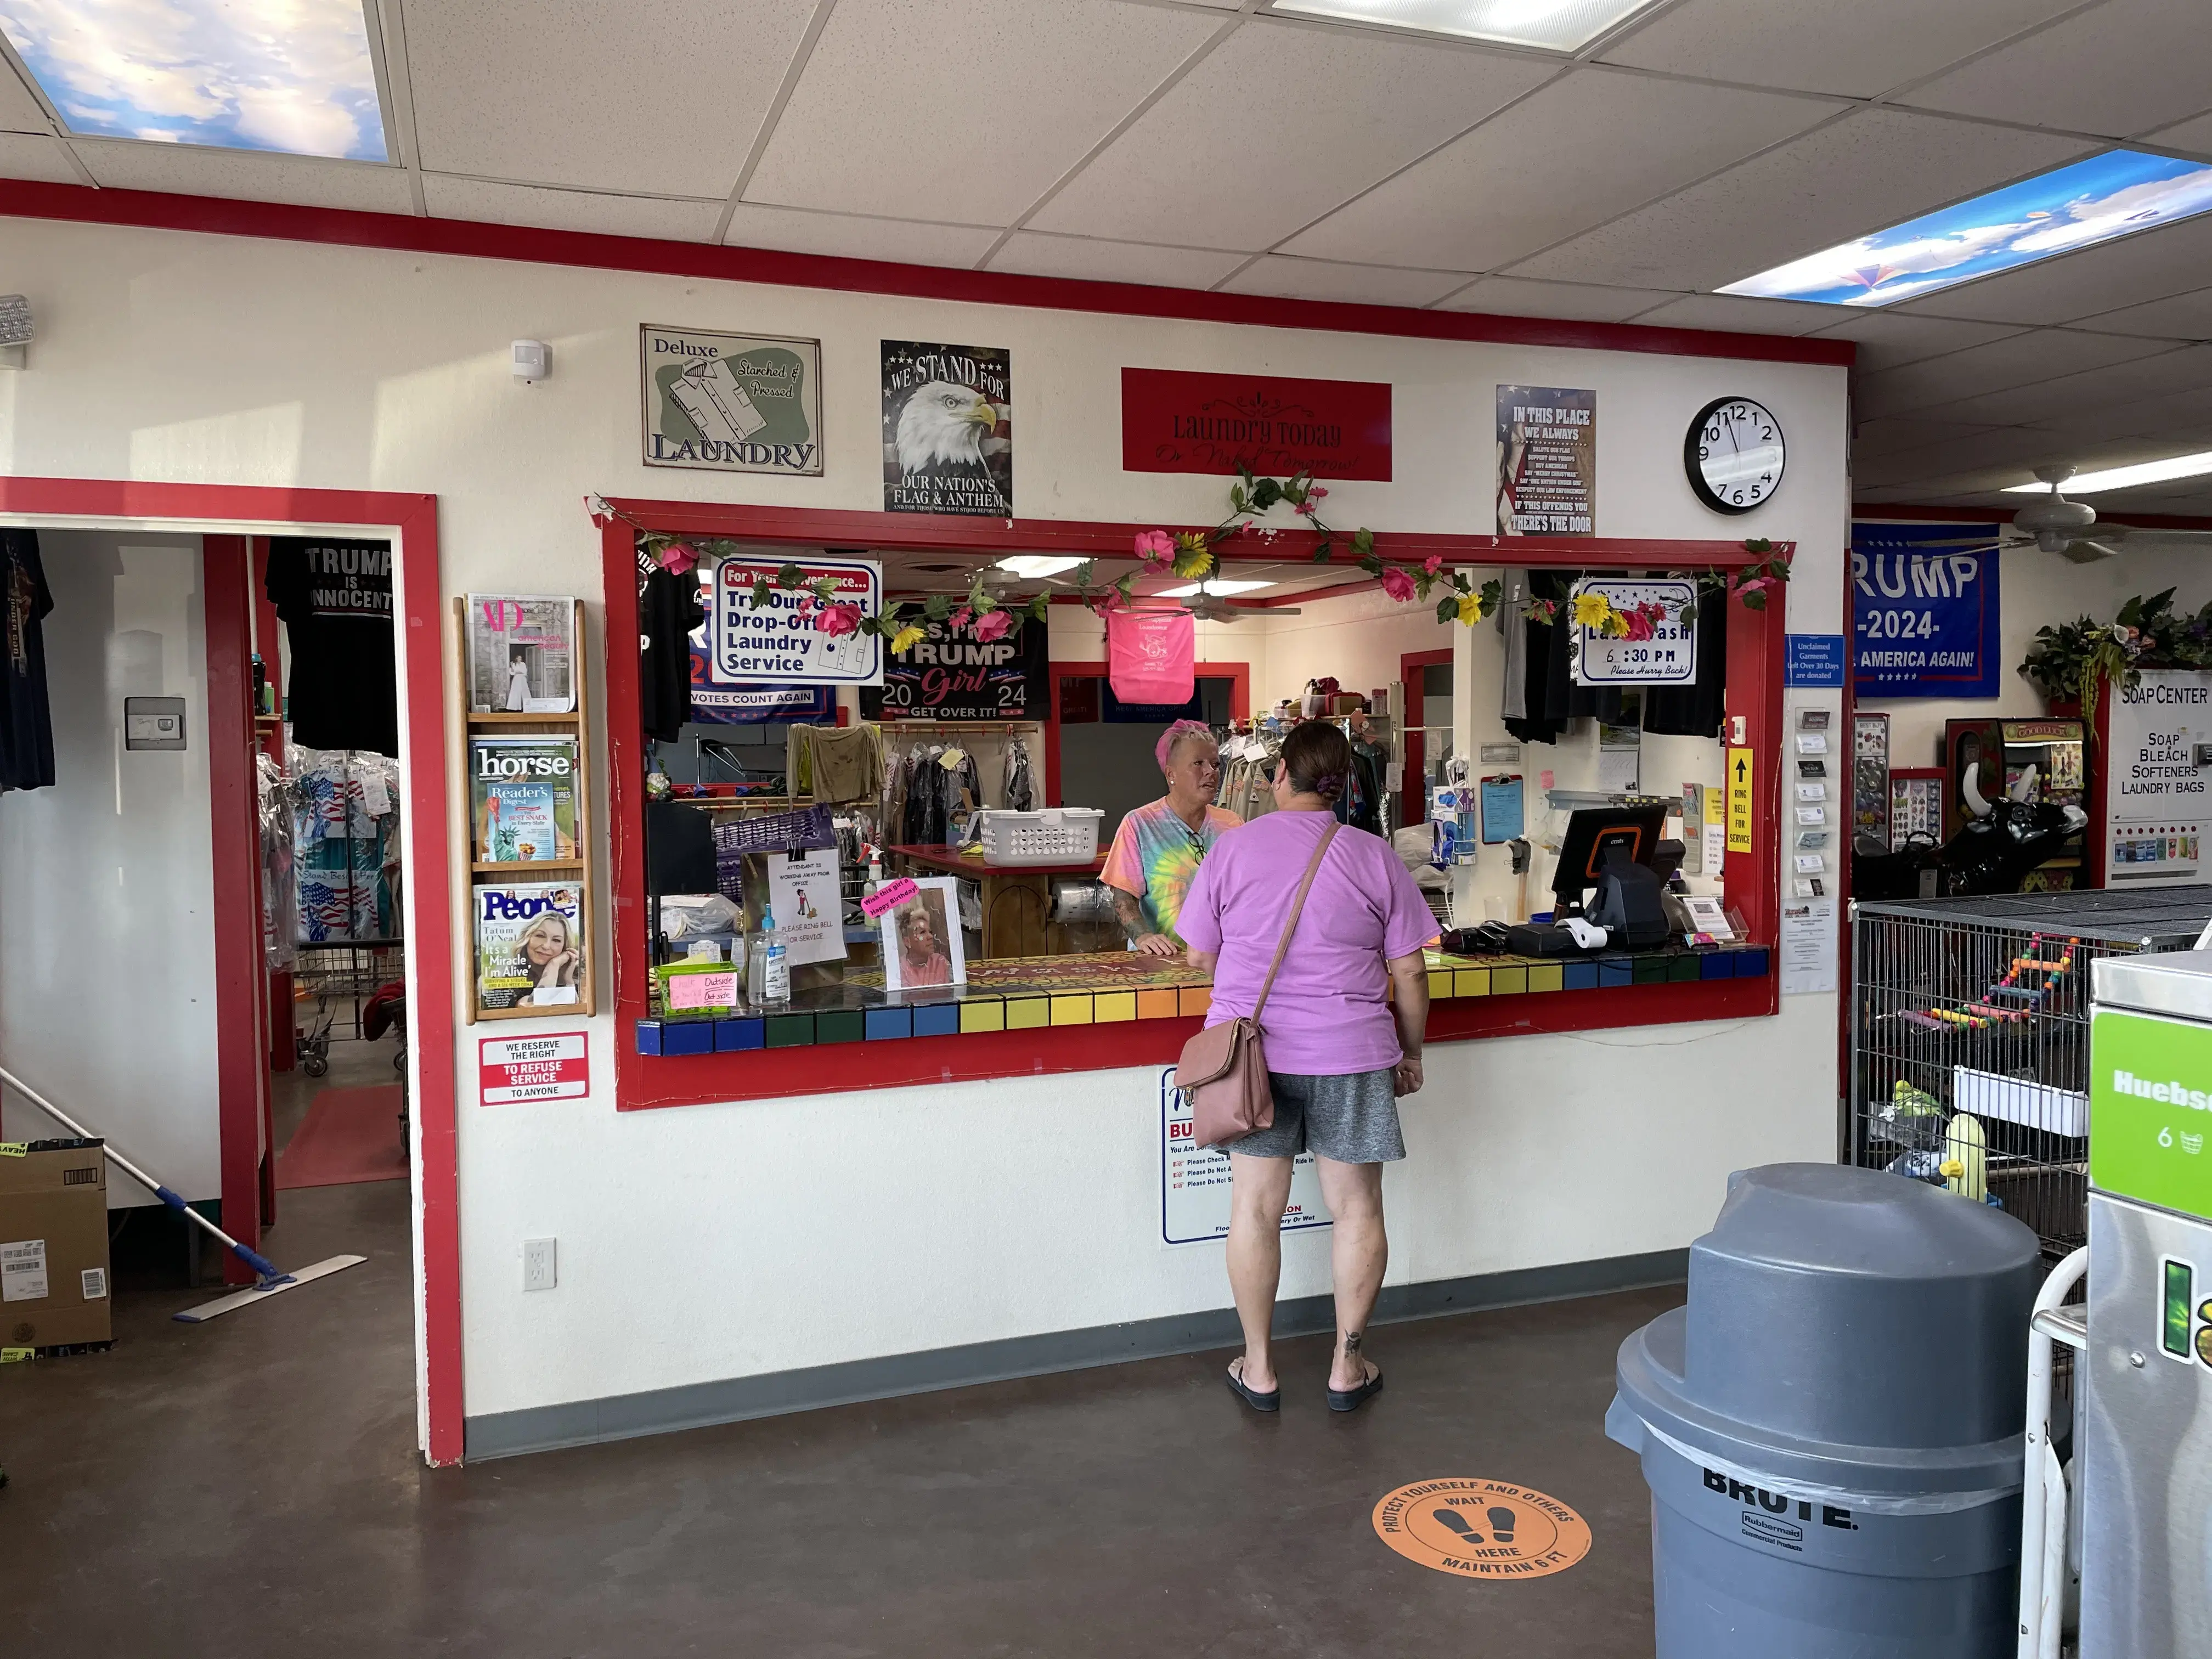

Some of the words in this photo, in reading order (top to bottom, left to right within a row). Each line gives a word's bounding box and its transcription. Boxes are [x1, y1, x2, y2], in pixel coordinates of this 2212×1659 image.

[654, 338, 718, 357] Deluxe
[737, 360, 786, 378] Starched
[791, 365, 800, 381] &
[891, 368, 911, 391] WE
[915, 355, 976, 385] STAND
[980, 371, 1004, 400] FOR
[751, 381, 793, 398] Pressed
[1514, 406, 1525, 422] IN
[1527, 407, 1553, 424] THIS
[1556, 408, 1590, 425] PLACE
[1715, 412, 1728, 426] 11
[1729, 405, 1746, 420] 12
[1752, 412, 1757, 426] 1
[1525, 426, 1540, 438] WE
[1542, 427, 1579, 440] ALWAYS
[1704, 427, 1720, 441] 10
[1762, 425, 1772, 439] 2
[652, 433, 816, 470] LAUNDRY
[1699, 446, 1708, 461] 9
[902, 475, 930, 489] OUR
[934, 476, 995, 493] NATION'S
[1761, 471, 1772, 483] 4
[1718, 484, 1727, 497] 7
[1733, 490, 1743, 504] 6
[1751, 485, 1760, 498] 5
[894, 490, 929, 504] FLAG
[933, 492, 942, 505] &
[946, 493, 1003, 507] ANTHEM
[1515, 500, 1522, 510] IF
[1525, 501, 1541, 510] THIS
[1542, 501, 1573, 511] OFFENDS
[1575, 503, 1588, 512] YOU
[1511, 515, 1548, 532] THERE'S
[1549, 516, 1568, 532] THE
[1569, 516, 1591, 532] DOOR
[305, 548, 392, 576] TRUMP
[727, 569, 748, 583] For
[1852, 552, 1978, 598] RUMP
[346, 576, 357, 589] IS
[727, 633, 812, 654] Laundry
[727, 654, 803, 671] Service
[1606, 650, 1613, 662] 6
[1861, 651, 1926, 667] AMERICA
[1929, 651, 1974, 667] AGAIN!
[1611, 665, 1634, 675] Please
[1637, 665, 1662, 677] Hurry
[1664, 665, 1688, 674] Back!
[1825, 663, 1839, 671] Days
[922, 667, 986, 705] Girl
[691, 694, 729, 703] VOTES
[732, 695, 773, 703] COUNT
[776, 693, 811, 702] AGAIN
[882, 684, 911, 706] 20
[998, 684, 1026, 706] 24
[2156, 685, 2207, 703] CENTER
[911, 707, 936, 716] GET
[940, 708, 977, 717] OVER
[979, 708, 996, 717] IT!
[2148, 732, 2180, 746] SOAP
[2140, 749, 2188, 761] BLEACH
[478, 749, 569, 776] horse
[2132, 765, 2198, 778] SOFTENERS
[492, 787, 548, 798] Reader's
[1735, 789, 1747, 799] RING
[2122, 781, 2170, 794] LAUNDRY
[2176, 782, 2204, 793] BAGS
[1734, 804, 1746, 814] BELL
[1735, 820, 1745, 828] FOR
[1729, 833, 1750, 844] SERVICE
[864, 894, 879, 906] Wish
[880, 888, 892, 898] this
[893, 881, 904, 891] girl
[870, 902, 889, 916] Happy
[890, 885, 918, 904] Birthday!
[781, 923, 802, 933] PLEASE
[799, 933, 823, 941] SERVICE
[490, 954, 526, 966] Miracle
[485, 966, 500, 977] I'm
[705, 977, 733, 986] Outside
[522, 1041, 560, 1050] RESERVE
[530, 1049, 556, 1058] RIGHT
[504, 1065, 517, 1075] TO
[521, 1062, 562, 1073] REFUSE
[511, 1073, 556, 1085] SERVICE
[524, 1086, 558, 1096] ANYONE
[2158, 1127, 2172, 1148] 6
[1380, 1497, 1407, 1533] PROTECT
[1401, 1482, 1479, 1498] YOURSELF
[1485, 1483, 1519, 1495] AND
[1522, 1493, 1574, 1523] OTHERS
[1444, 1497, 1484, 1505] WAIT
[1745, 1515, 1800, 1537] Rubbermaid
[1742, 1528, 1775, 1544] Commercial
[1777, 1540, 1802, 1551] Products
[1475, 1548, 1522, 1557] HERE
[1442, 1557, 1534, 1575] MAINTAIN
[1535, 1559, 1548, 1567] 6
[1549, 1550, 1568, 1564] FT
